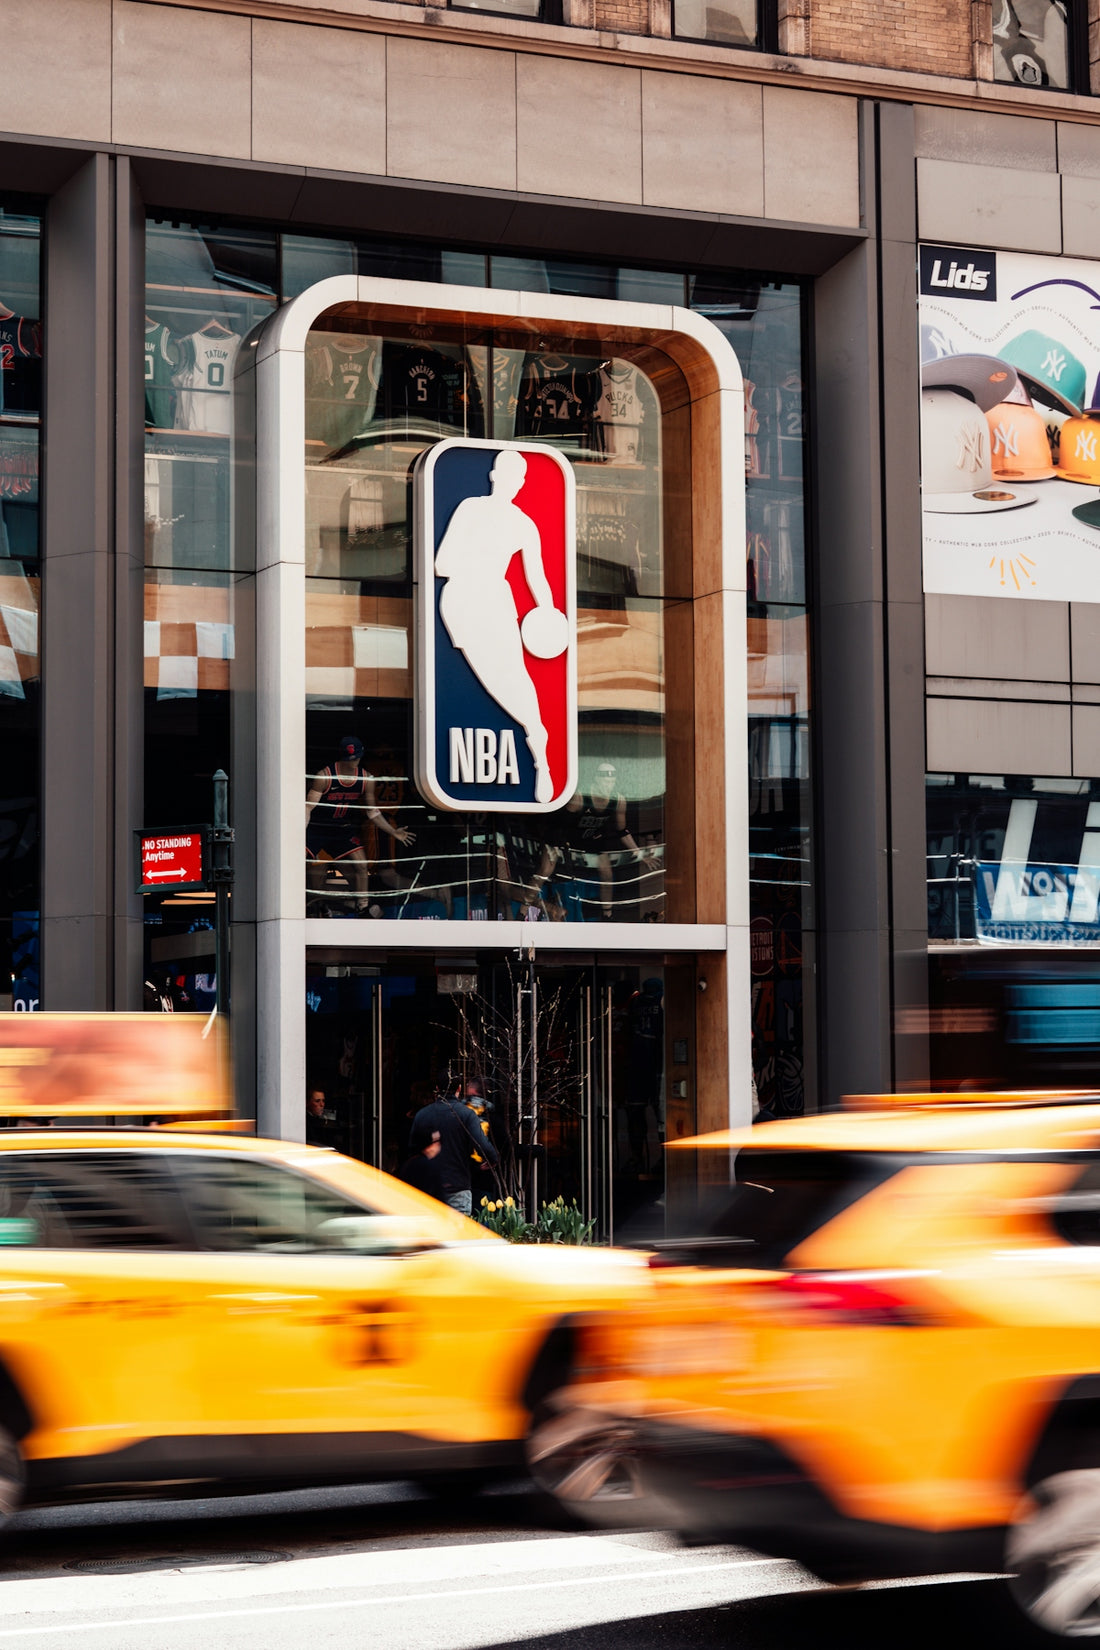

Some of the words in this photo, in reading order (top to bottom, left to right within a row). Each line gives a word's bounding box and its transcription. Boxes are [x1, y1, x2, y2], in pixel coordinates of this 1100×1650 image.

[930, 260, 991, 291] Lids
[204, 349, 229, 360] TATUM
[207, 362, 224, 386] 0
[339, 363, 363, 374] BROWN
[343, 375, 359, 399] 7
[417, 378, 427, 401] 5
[610, 403, 627, 417] 34
[1000, 535, 1032, 546] COLLECTION
[449, 727, 520, 785] NBA
[144, 840, 155, 850] NO
[156, 837, 192, 849] STANDING
[145, 851, 175, 863] Anytime
[751, 931, 773, 946] ETROIT
[751, 947, 774, 962] ISTONS
